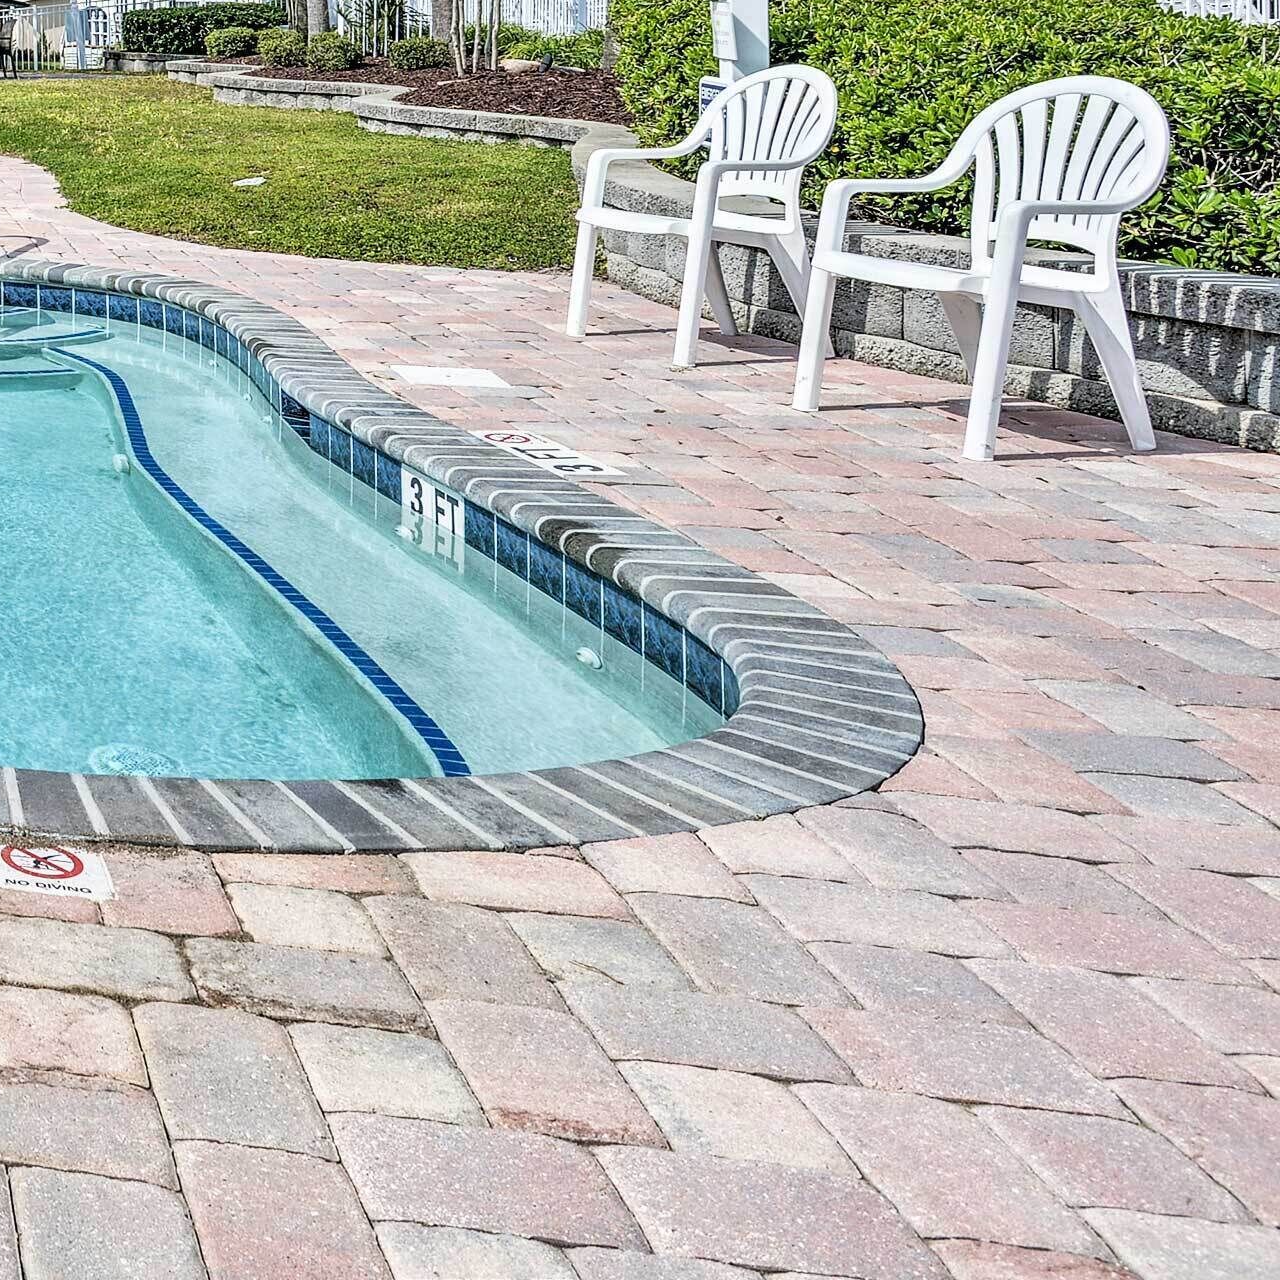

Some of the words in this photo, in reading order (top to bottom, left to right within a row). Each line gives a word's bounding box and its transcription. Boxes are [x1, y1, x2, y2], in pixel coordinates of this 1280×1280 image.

[410, 477, 423, 515] 3
[434, 487, 459, 535] FT
[5, 878, 30, 886] NO
[35, 882, 92, 894] DIVING
